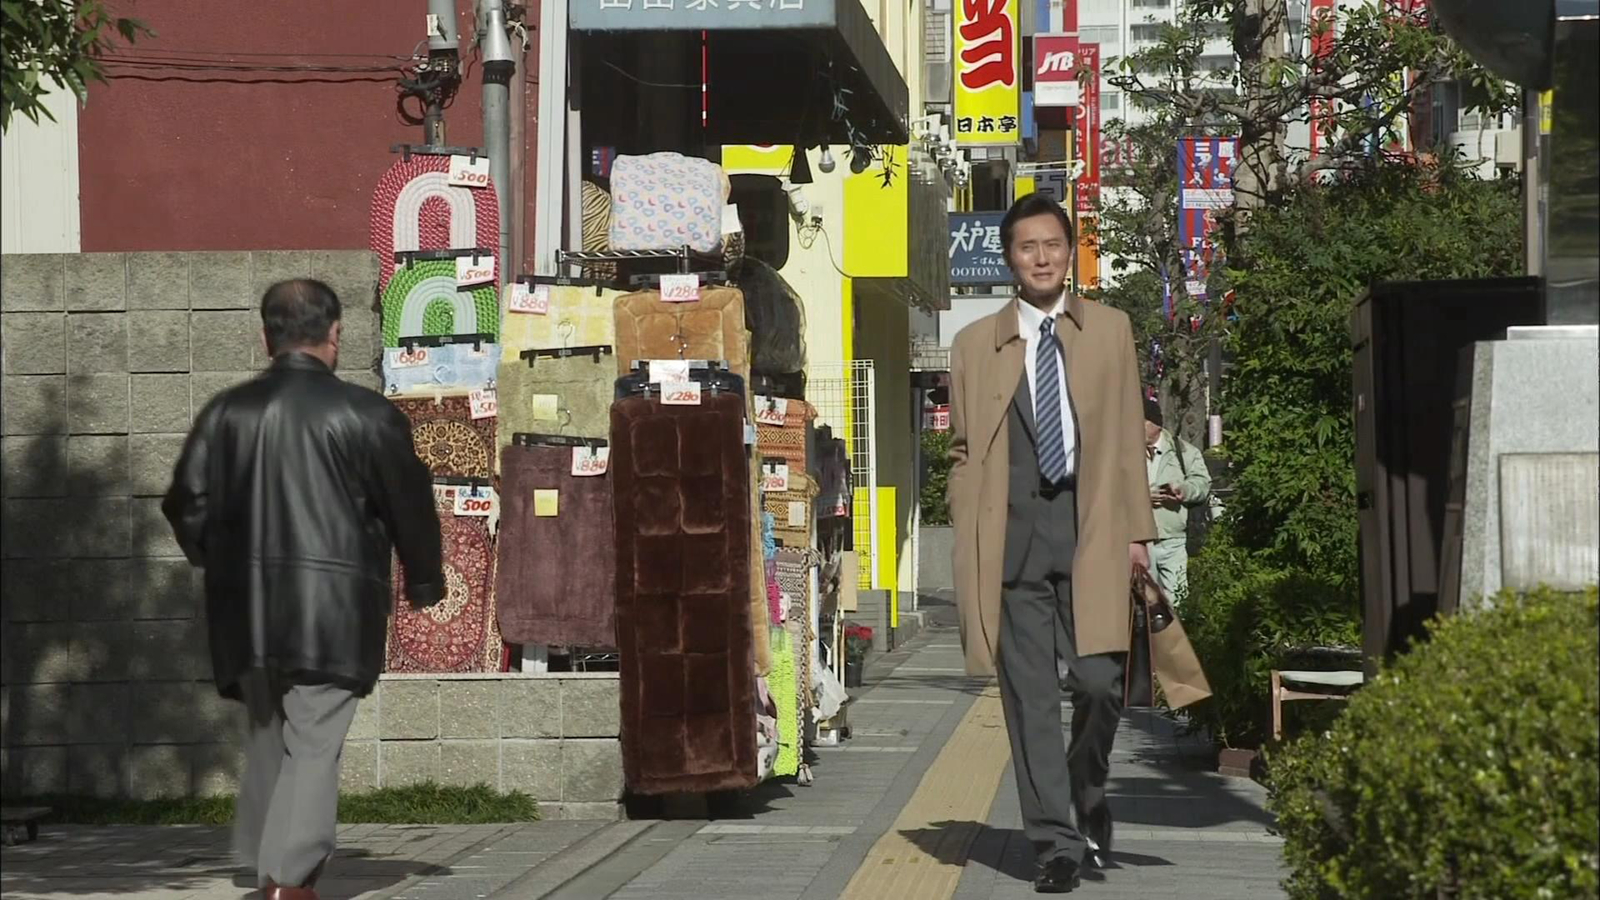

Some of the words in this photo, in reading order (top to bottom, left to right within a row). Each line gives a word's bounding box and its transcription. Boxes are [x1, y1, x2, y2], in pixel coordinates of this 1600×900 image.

[1037, 51, 1074, 75] JTB
[957, 115, 1017, 133] 日本亭
[948, 220, 1005, 259] 大戸屋
[951, 266, 1001, 277] OOTOYA
